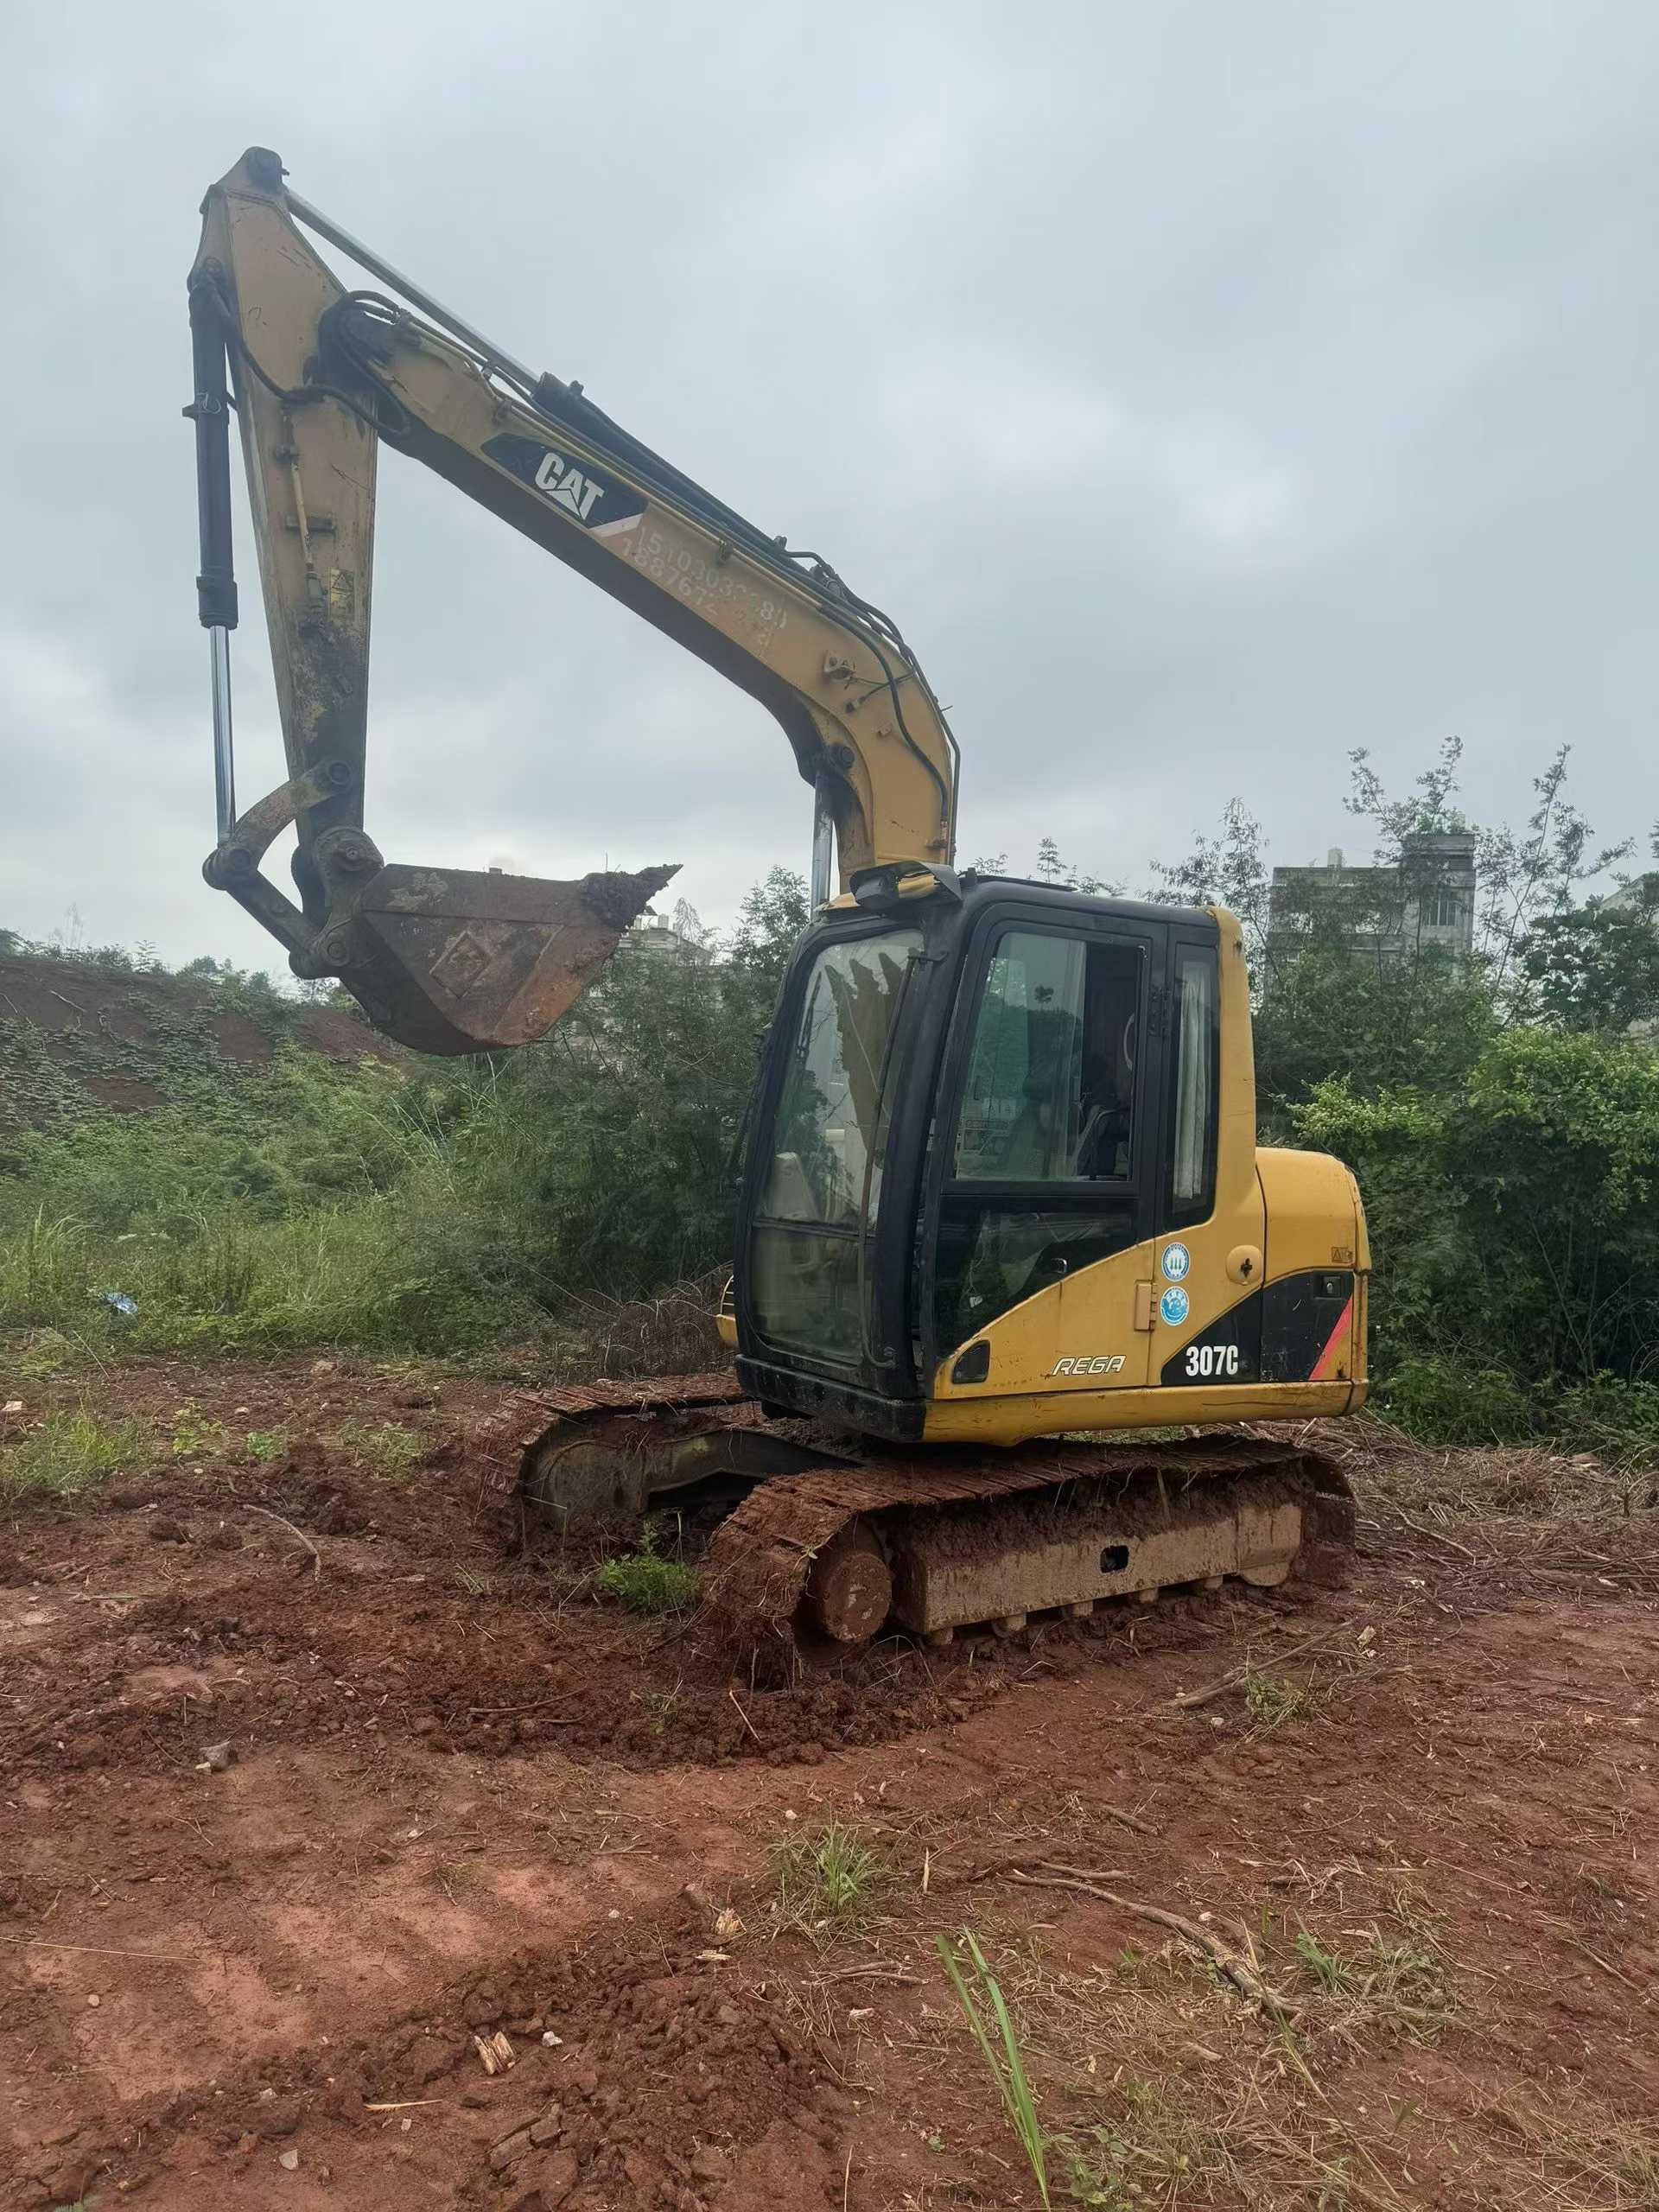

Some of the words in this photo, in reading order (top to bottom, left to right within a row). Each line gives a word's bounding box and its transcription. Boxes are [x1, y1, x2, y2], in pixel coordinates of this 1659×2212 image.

[534, 452, 605, 520] CAT
[1052, 1354, 1127, 1377] REGA
[1185, 1344, 1239, 1376] 307C
